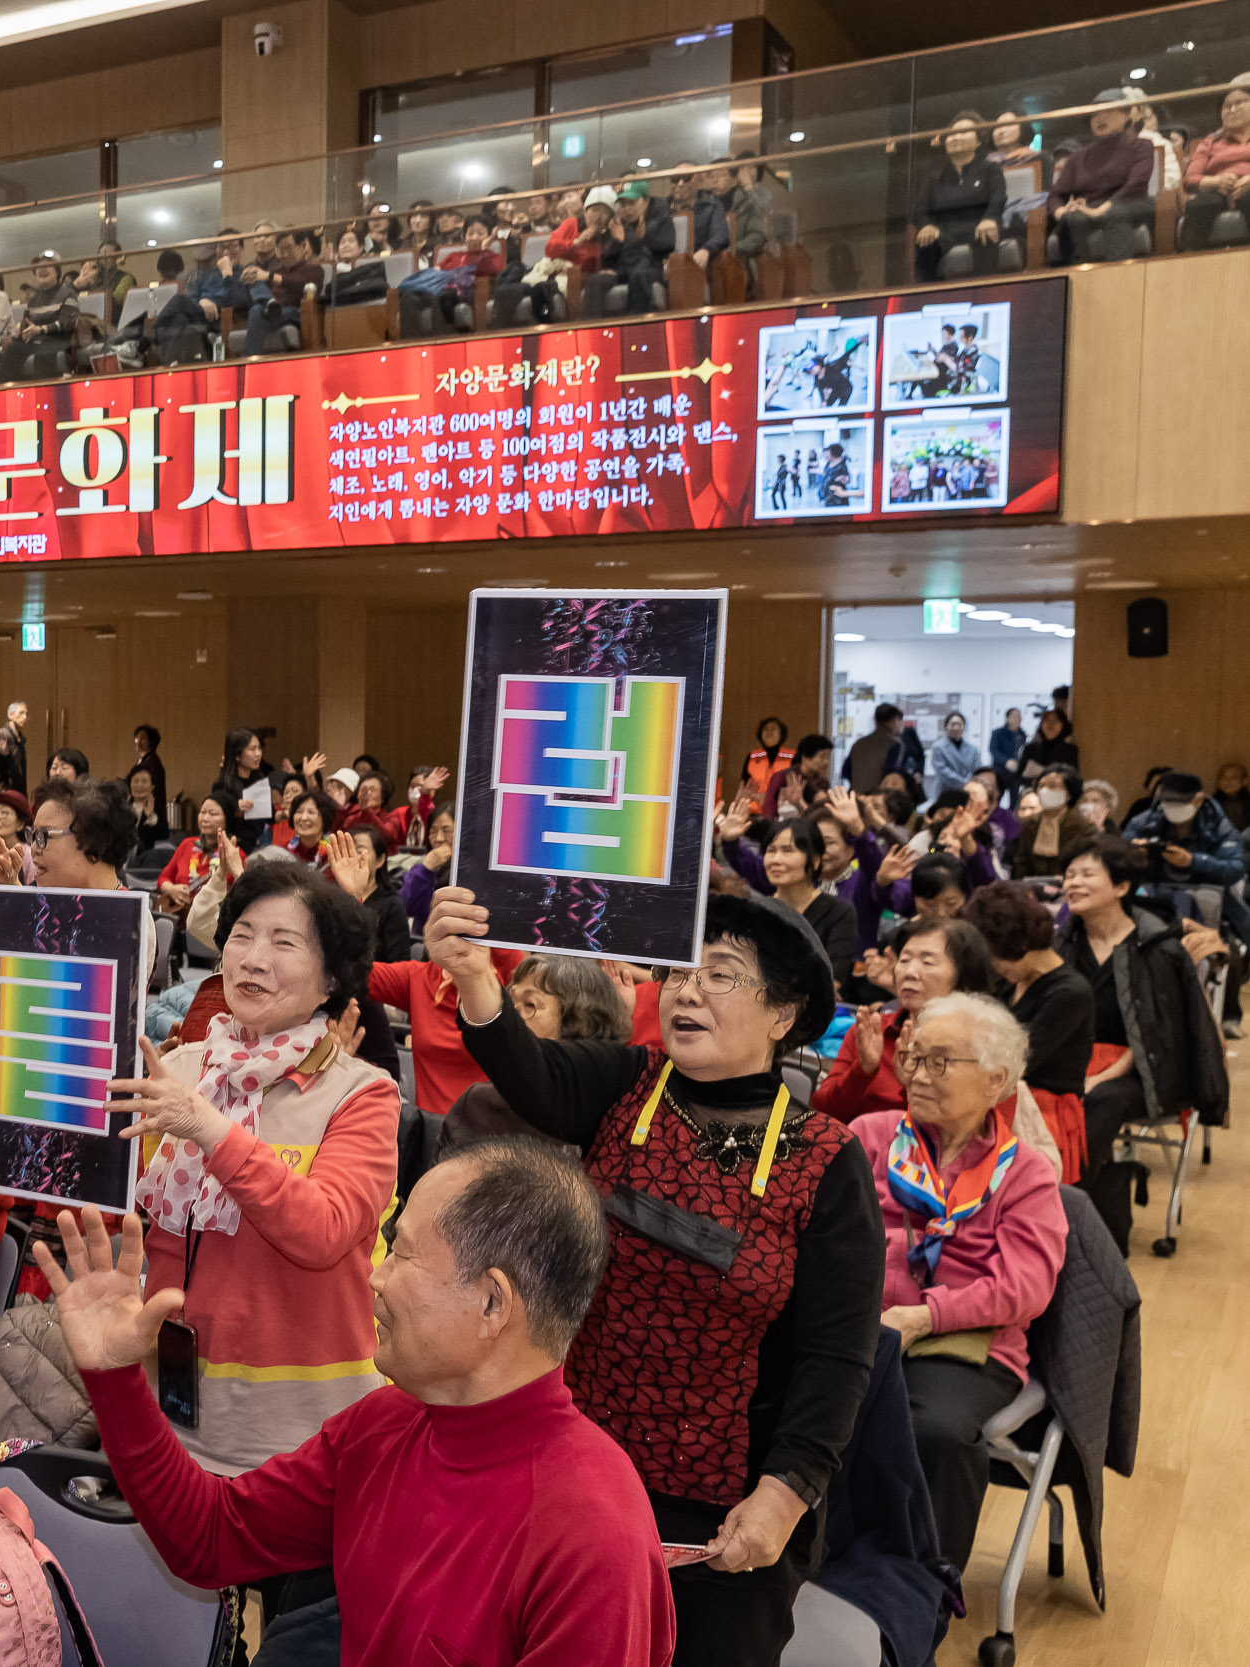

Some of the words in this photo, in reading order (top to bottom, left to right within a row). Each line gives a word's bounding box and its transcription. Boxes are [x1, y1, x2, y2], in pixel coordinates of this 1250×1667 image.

[434, 354, 601, 397] 자양문화제란?
[328, 413, 446, 443] 자양노인복지관
[449, 406, 533, 434] 600여명의
[538, 401, 593, 427] 회원이
[599, 395, 648, 422] 1년간
[653, 392, 693, 418] 배운
[328, 444, 416, 470] 색연필아트,
[478, 438, 496, 460] 등
[502, 430, 585, 457] 100여점의
[591, 422, 688, 452] 작품전시와
[692, 420, 739, 445] 댄스,
[328, 475, 366, 496] 체조,
[371, 471, 409, 494] 노래,
[458, 464, 493, 488] 악기
[500, 463, 518, 486] 등
[523, 458, 579, 484] 다양한
[583, 454, 641, 481] 공연을
[645, 452, 691, 476] 가족,
[328, 499, 393, 522] 지인에게
[399, 496, 450, 519] 뽐내는
[455, 493, 491, 516] 자양
[495, 490, 532, 514] 문화
[538, 483, 655, 513] 한마당입니다.
